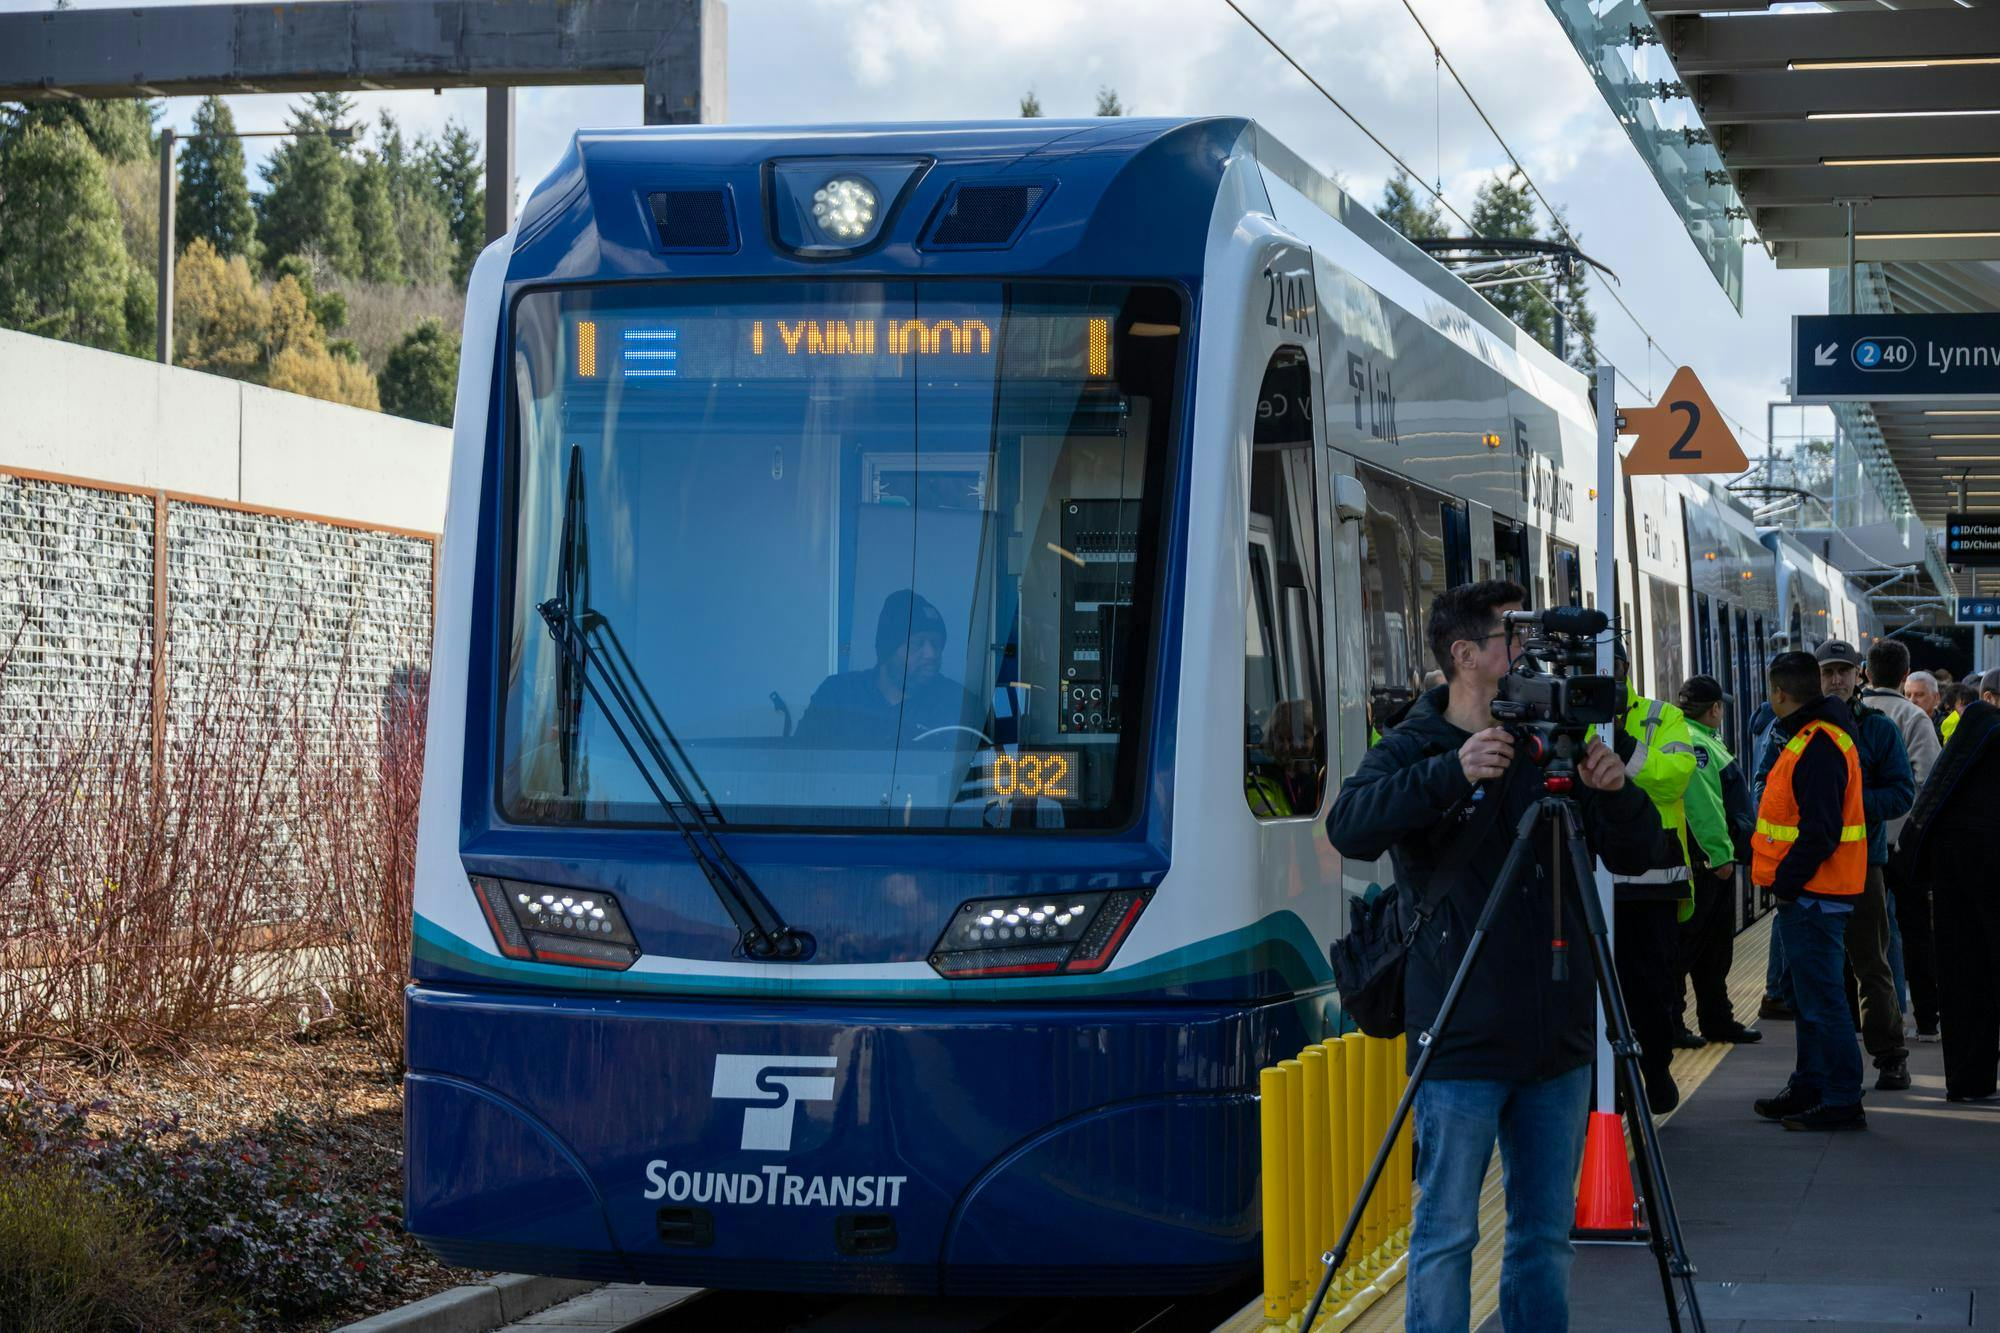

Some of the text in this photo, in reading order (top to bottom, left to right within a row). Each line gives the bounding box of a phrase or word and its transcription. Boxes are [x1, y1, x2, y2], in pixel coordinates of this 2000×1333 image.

[1863, 346, 1875, 363] 2
[1883, 345, 1908, 364] 40
[1368, 361, 1399, 446] Link
[1669, 400, 1702, 460] 2
[994, 755, 1067, 796] 032
